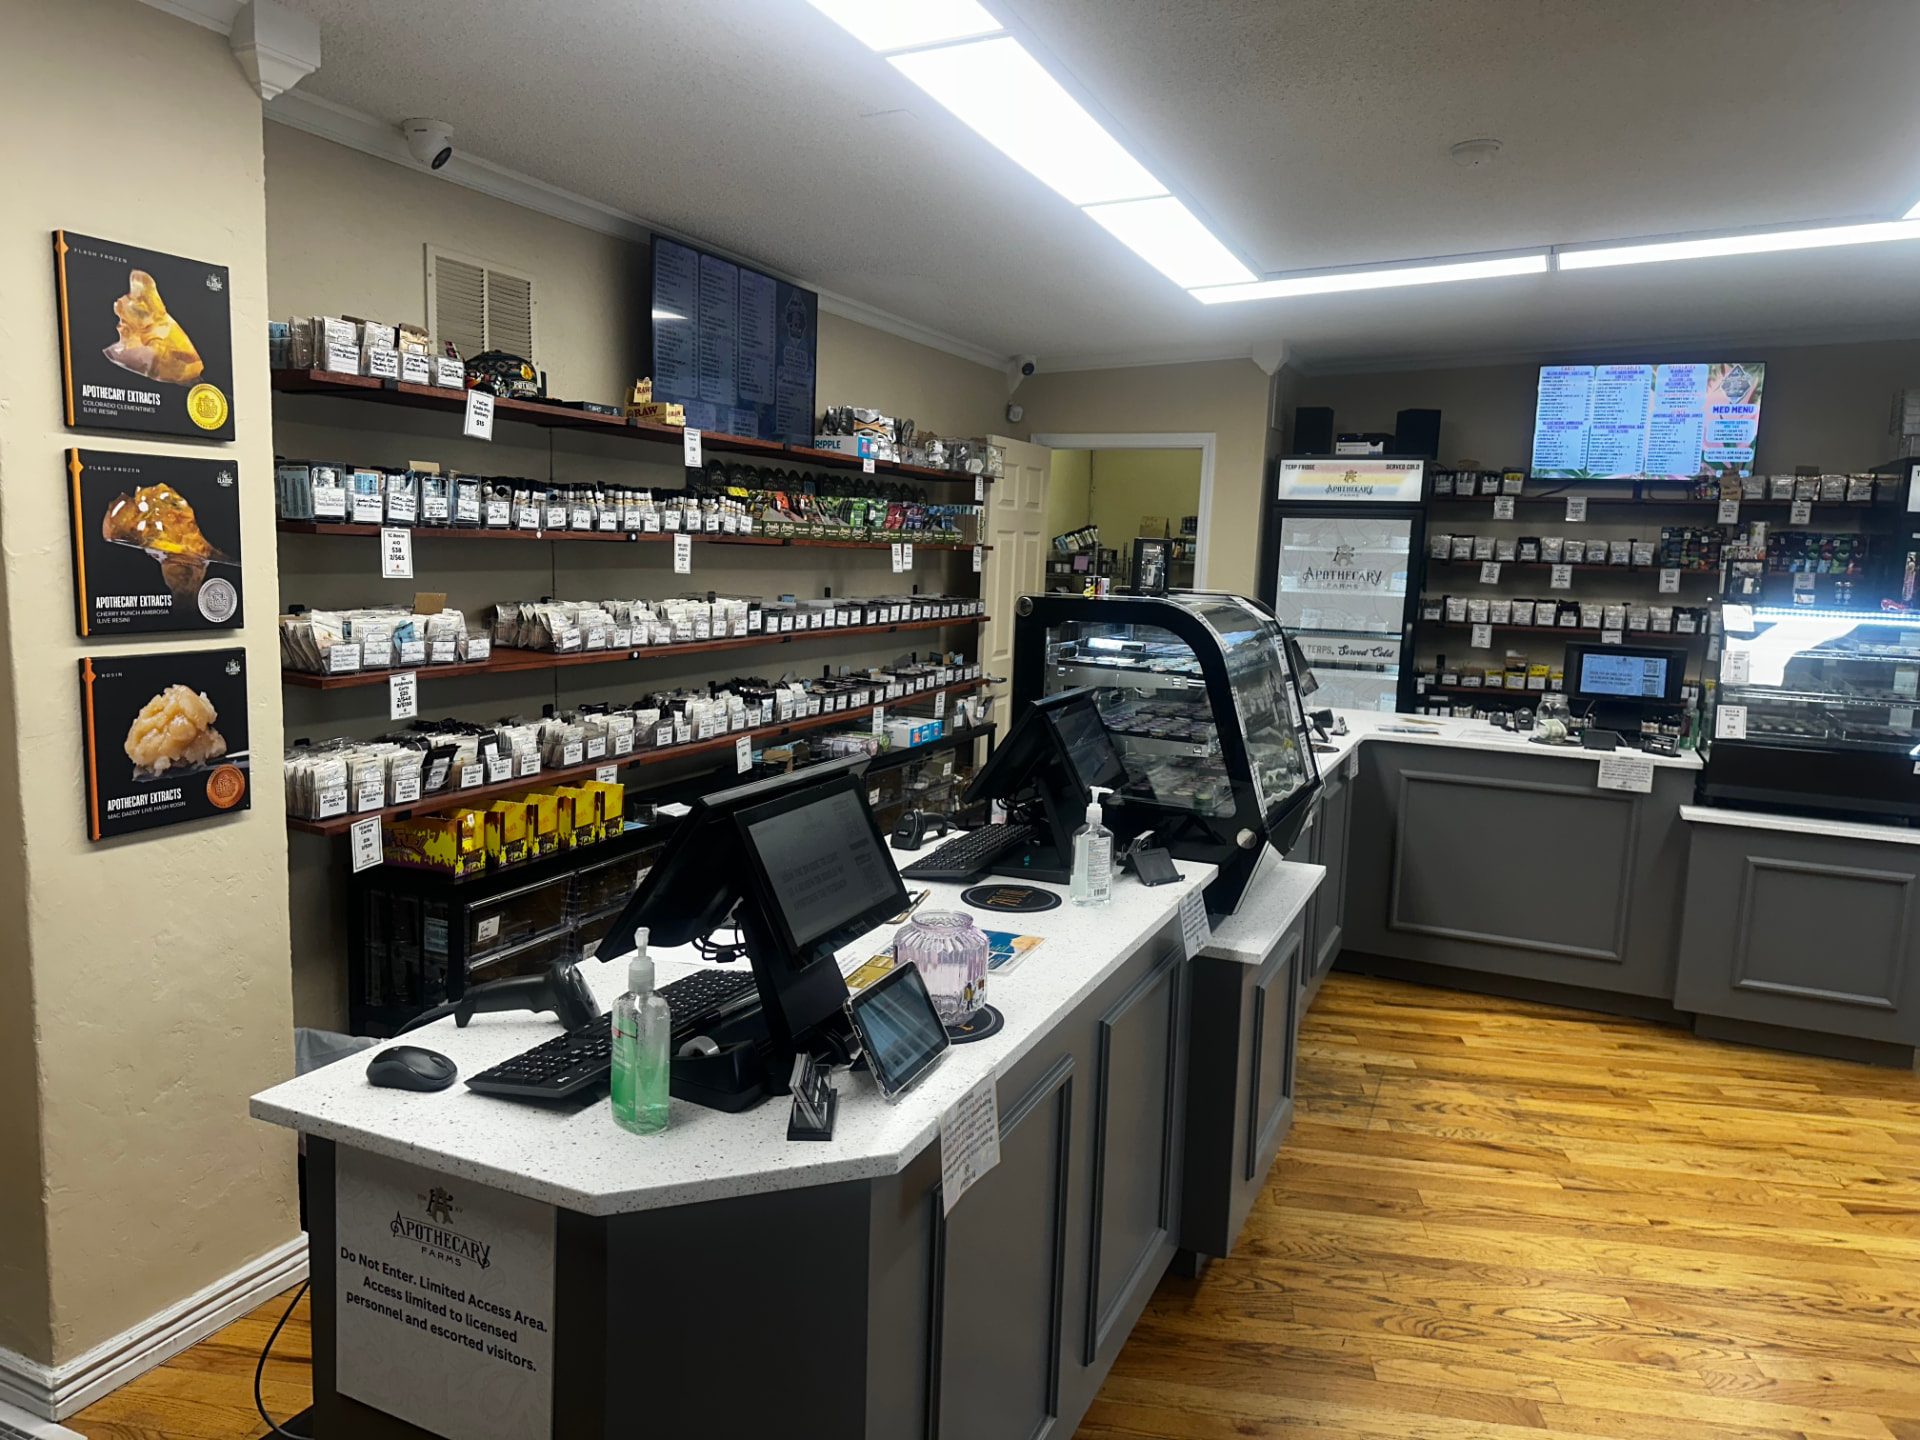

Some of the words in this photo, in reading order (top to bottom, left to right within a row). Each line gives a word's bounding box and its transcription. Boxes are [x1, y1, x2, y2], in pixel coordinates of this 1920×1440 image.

[82, 384, 125, 401] APOTHECARY
[128, 390, 160, 406] EXTRACTS
[83, 400, 115, 409] COLORADO
[117, 404, 155, 413] CLEMENTINES
[634, 406, 658, 417] RAW
[1326, 484, 1373, 495] APOTHECARY
[1303, 566, 1382, 586] APOTHECARY
[96, 596, 138, 609] APOTHECARY
[140, 594, 172, 607] EXTRACTS
[1338, 644, 1368, 656] Served
[1370, 646, 1394, 658] Cold
[107, 794, 148, 811] APOTHECARY
[150, 788, 182, 802] EXTRACTS
[108, 812, 120, 820] MAC
[122, 809, 140, 818] DADDY
[142, 807, 153, 815] LIVE
[170, 801, 186, 809] ROSIN
[390, 1210, 491, 1270] APOTHECARY
[421, 1247, 462, 1267] FARMS
[341, 1247, 356, 1263] Do
[359, 1255, 380, 1272] Not
[382, 1262, 416, 1285] Enter.
[420, 1276, 465, 1303] Limited
[468, 1295, 511, 1319] Access
[514, 1310, 548, 1333] Area.
[363, 1276, 402, 1300] Access
[405, 1291, 447, 1317] limited
[450, 1309, 463, 1323] to
[466, 1313, 517, 1343] licensed
[346, 1291, 403, 1321] personnel
[405, 1313, 427, 1331] and
[430, 1324, 483, 1352] escorted
[487, 1344, 537, 1371] visitors.
